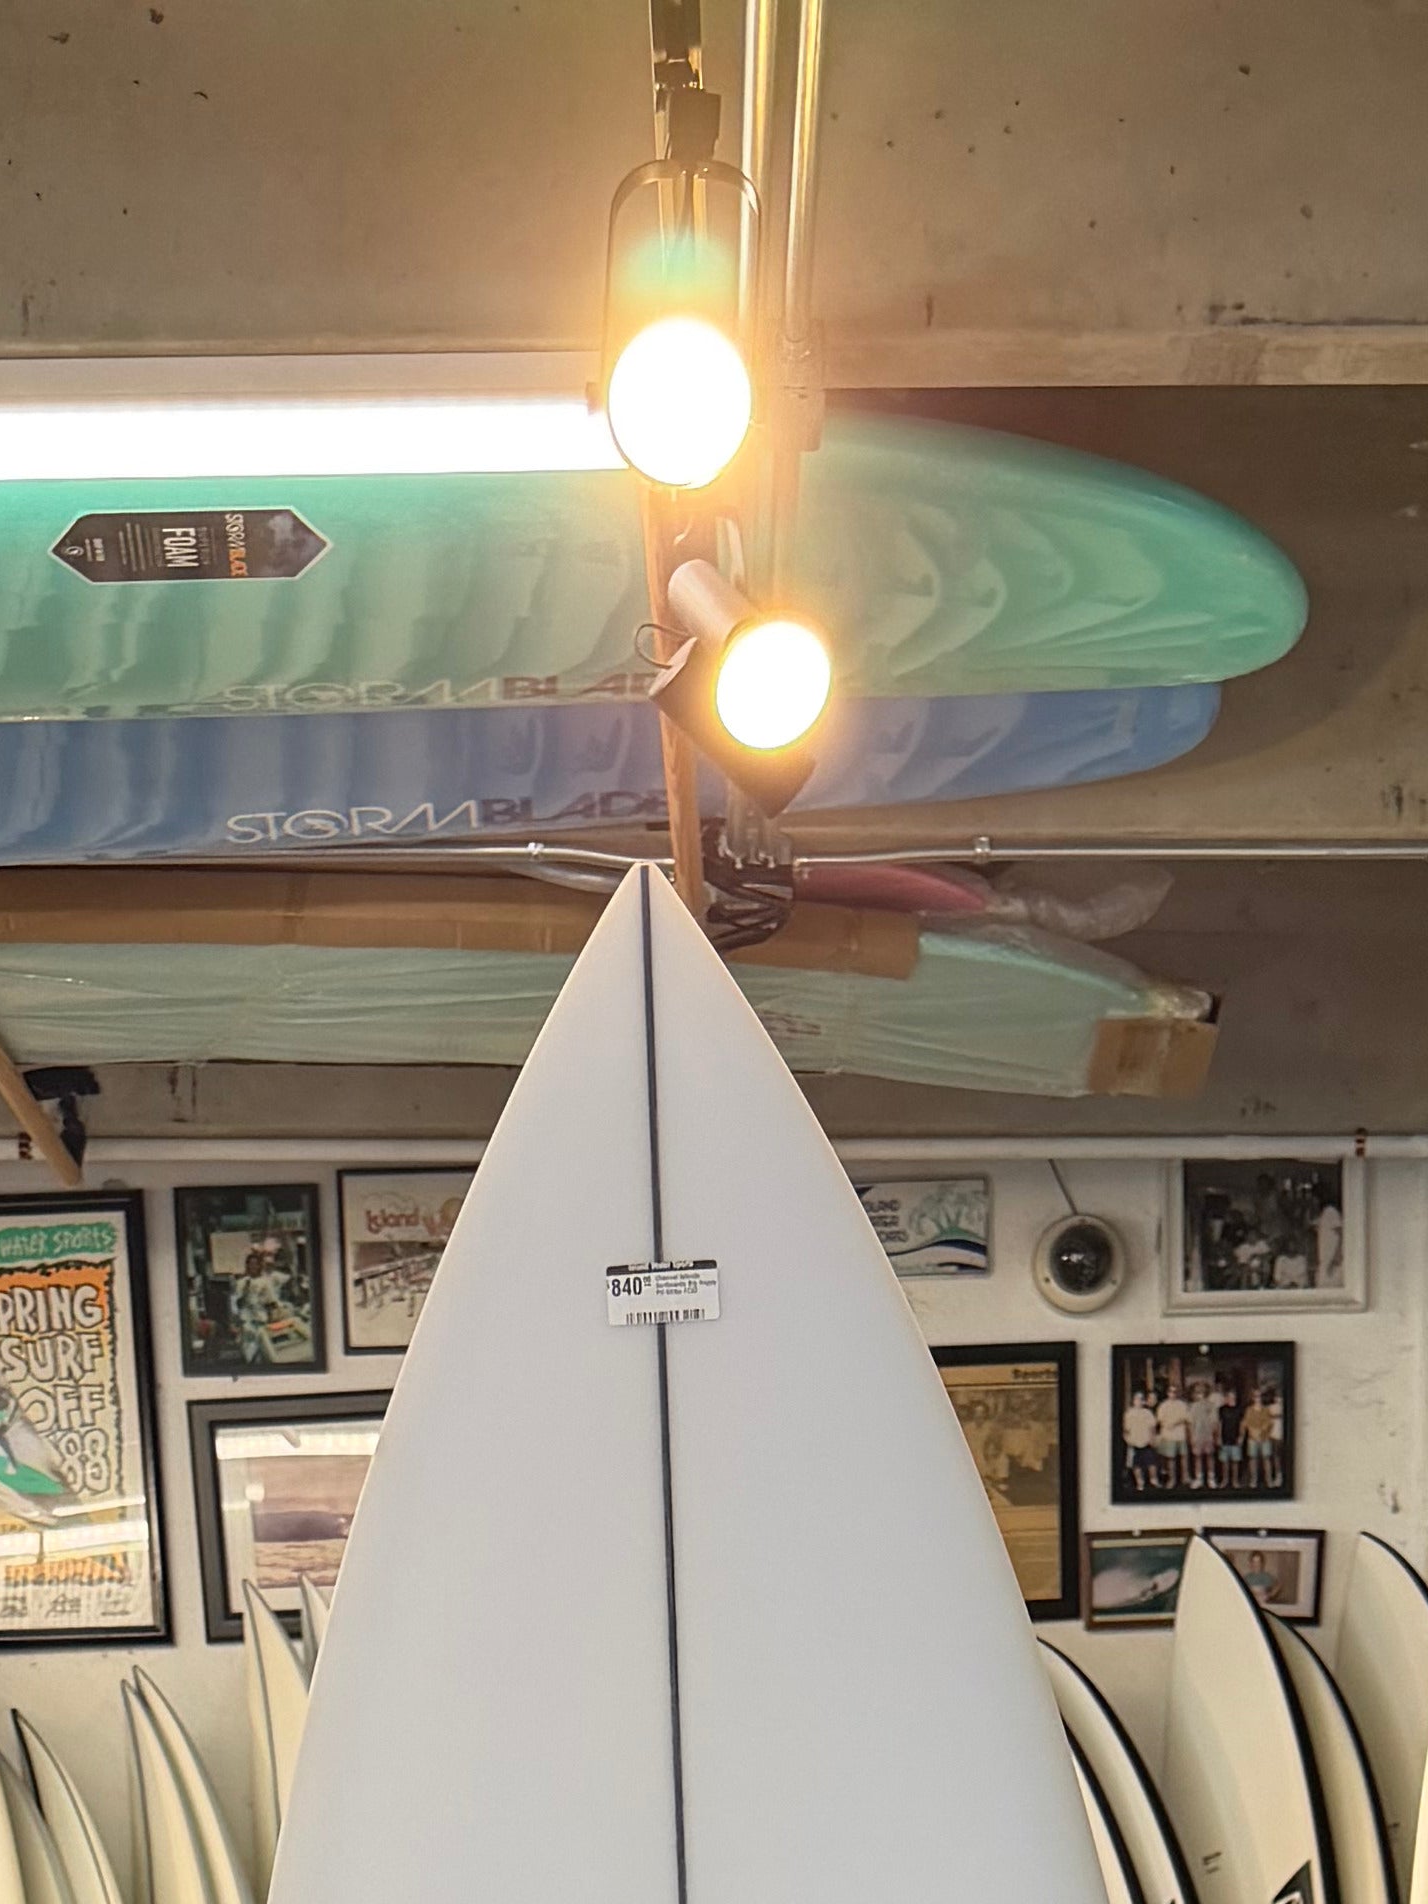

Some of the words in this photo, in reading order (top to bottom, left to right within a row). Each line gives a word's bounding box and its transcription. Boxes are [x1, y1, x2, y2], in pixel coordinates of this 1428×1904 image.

[161, 527, 200, 568] FOAM
[221, 672, 660, 712] STORMBLAD
[53, 1228, 113, 1251] SPORTS
[16, 1384, 106, 1435] OFF
